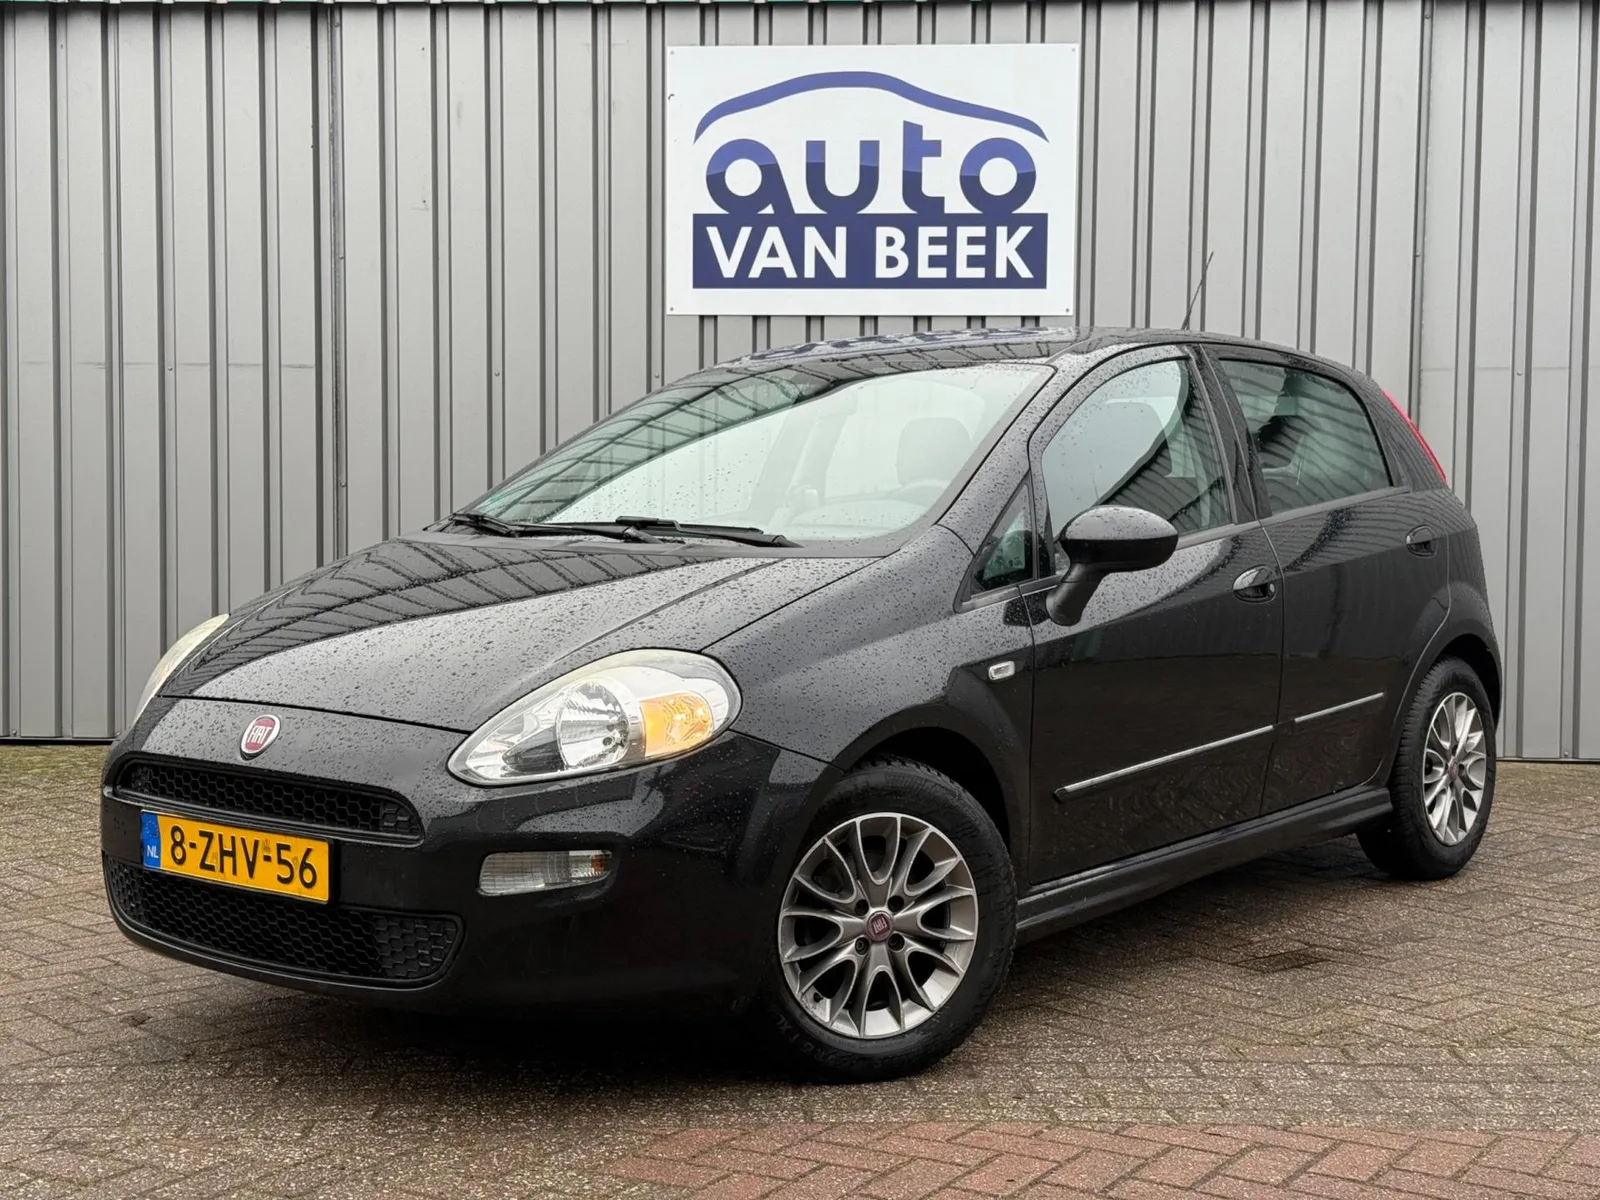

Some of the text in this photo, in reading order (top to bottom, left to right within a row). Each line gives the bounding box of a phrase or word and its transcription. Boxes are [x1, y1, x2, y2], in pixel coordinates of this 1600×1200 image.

[706, 120, 1037, 214] auto
[706, 225, 1034, 279] VAN BEEK
[247, 725, 273, 744] FIAT
[147, 844, 159, 860] NL
[170, 825, 318, 889] 8-ZHV-56
